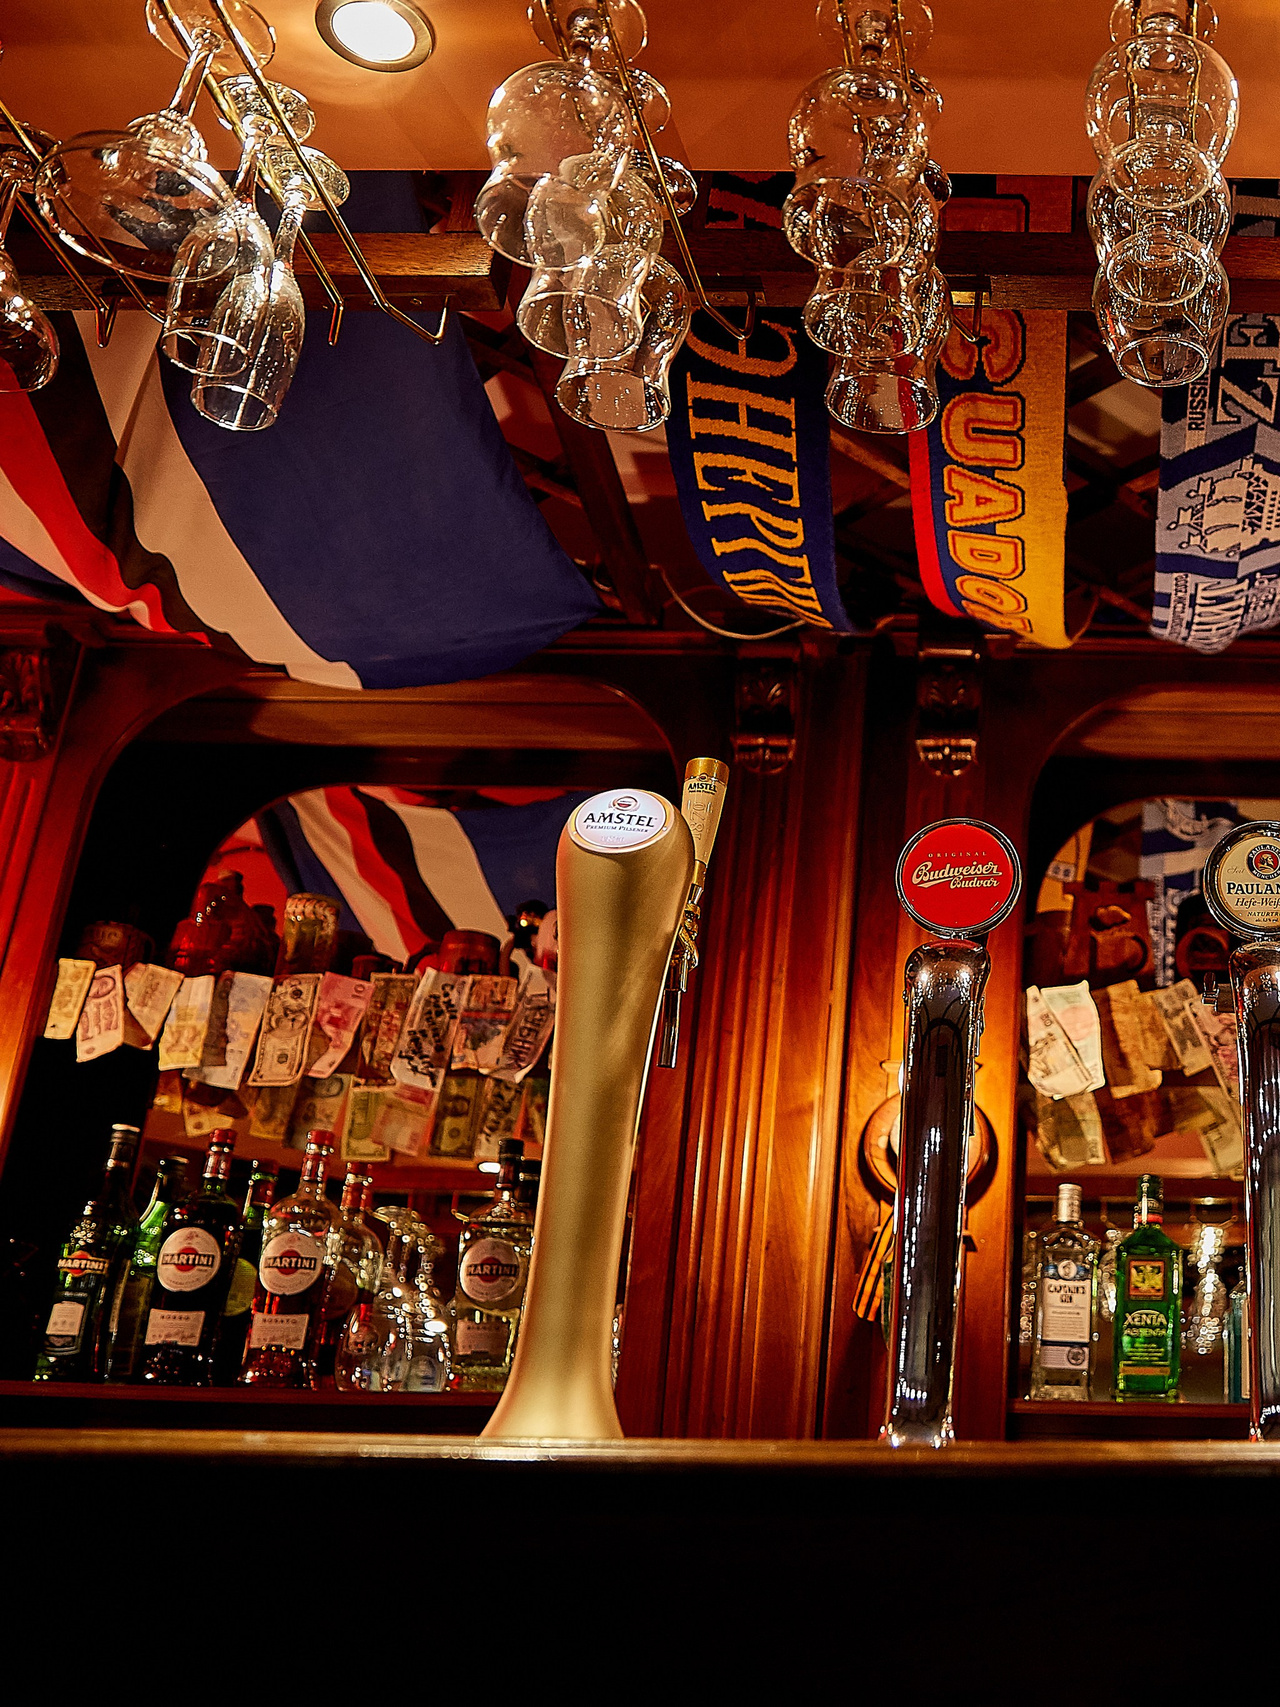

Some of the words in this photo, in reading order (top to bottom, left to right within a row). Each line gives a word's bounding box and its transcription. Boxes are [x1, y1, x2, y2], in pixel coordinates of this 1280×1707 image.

[687, 782, 718, 793] AMSTEL
[583, 812, 656, 828] AMSTEL
[911, 861, 1003, 888] Budweiser
[949, 876, 1000, 889] Budvar
[57, 1257, 107, 1272] MARTINI
[162, 1253, 214, 1267] MARTINI
[264, 1256, 317, 1271] MARTINI
[467, 1262, 519, 1278] MARTINI
